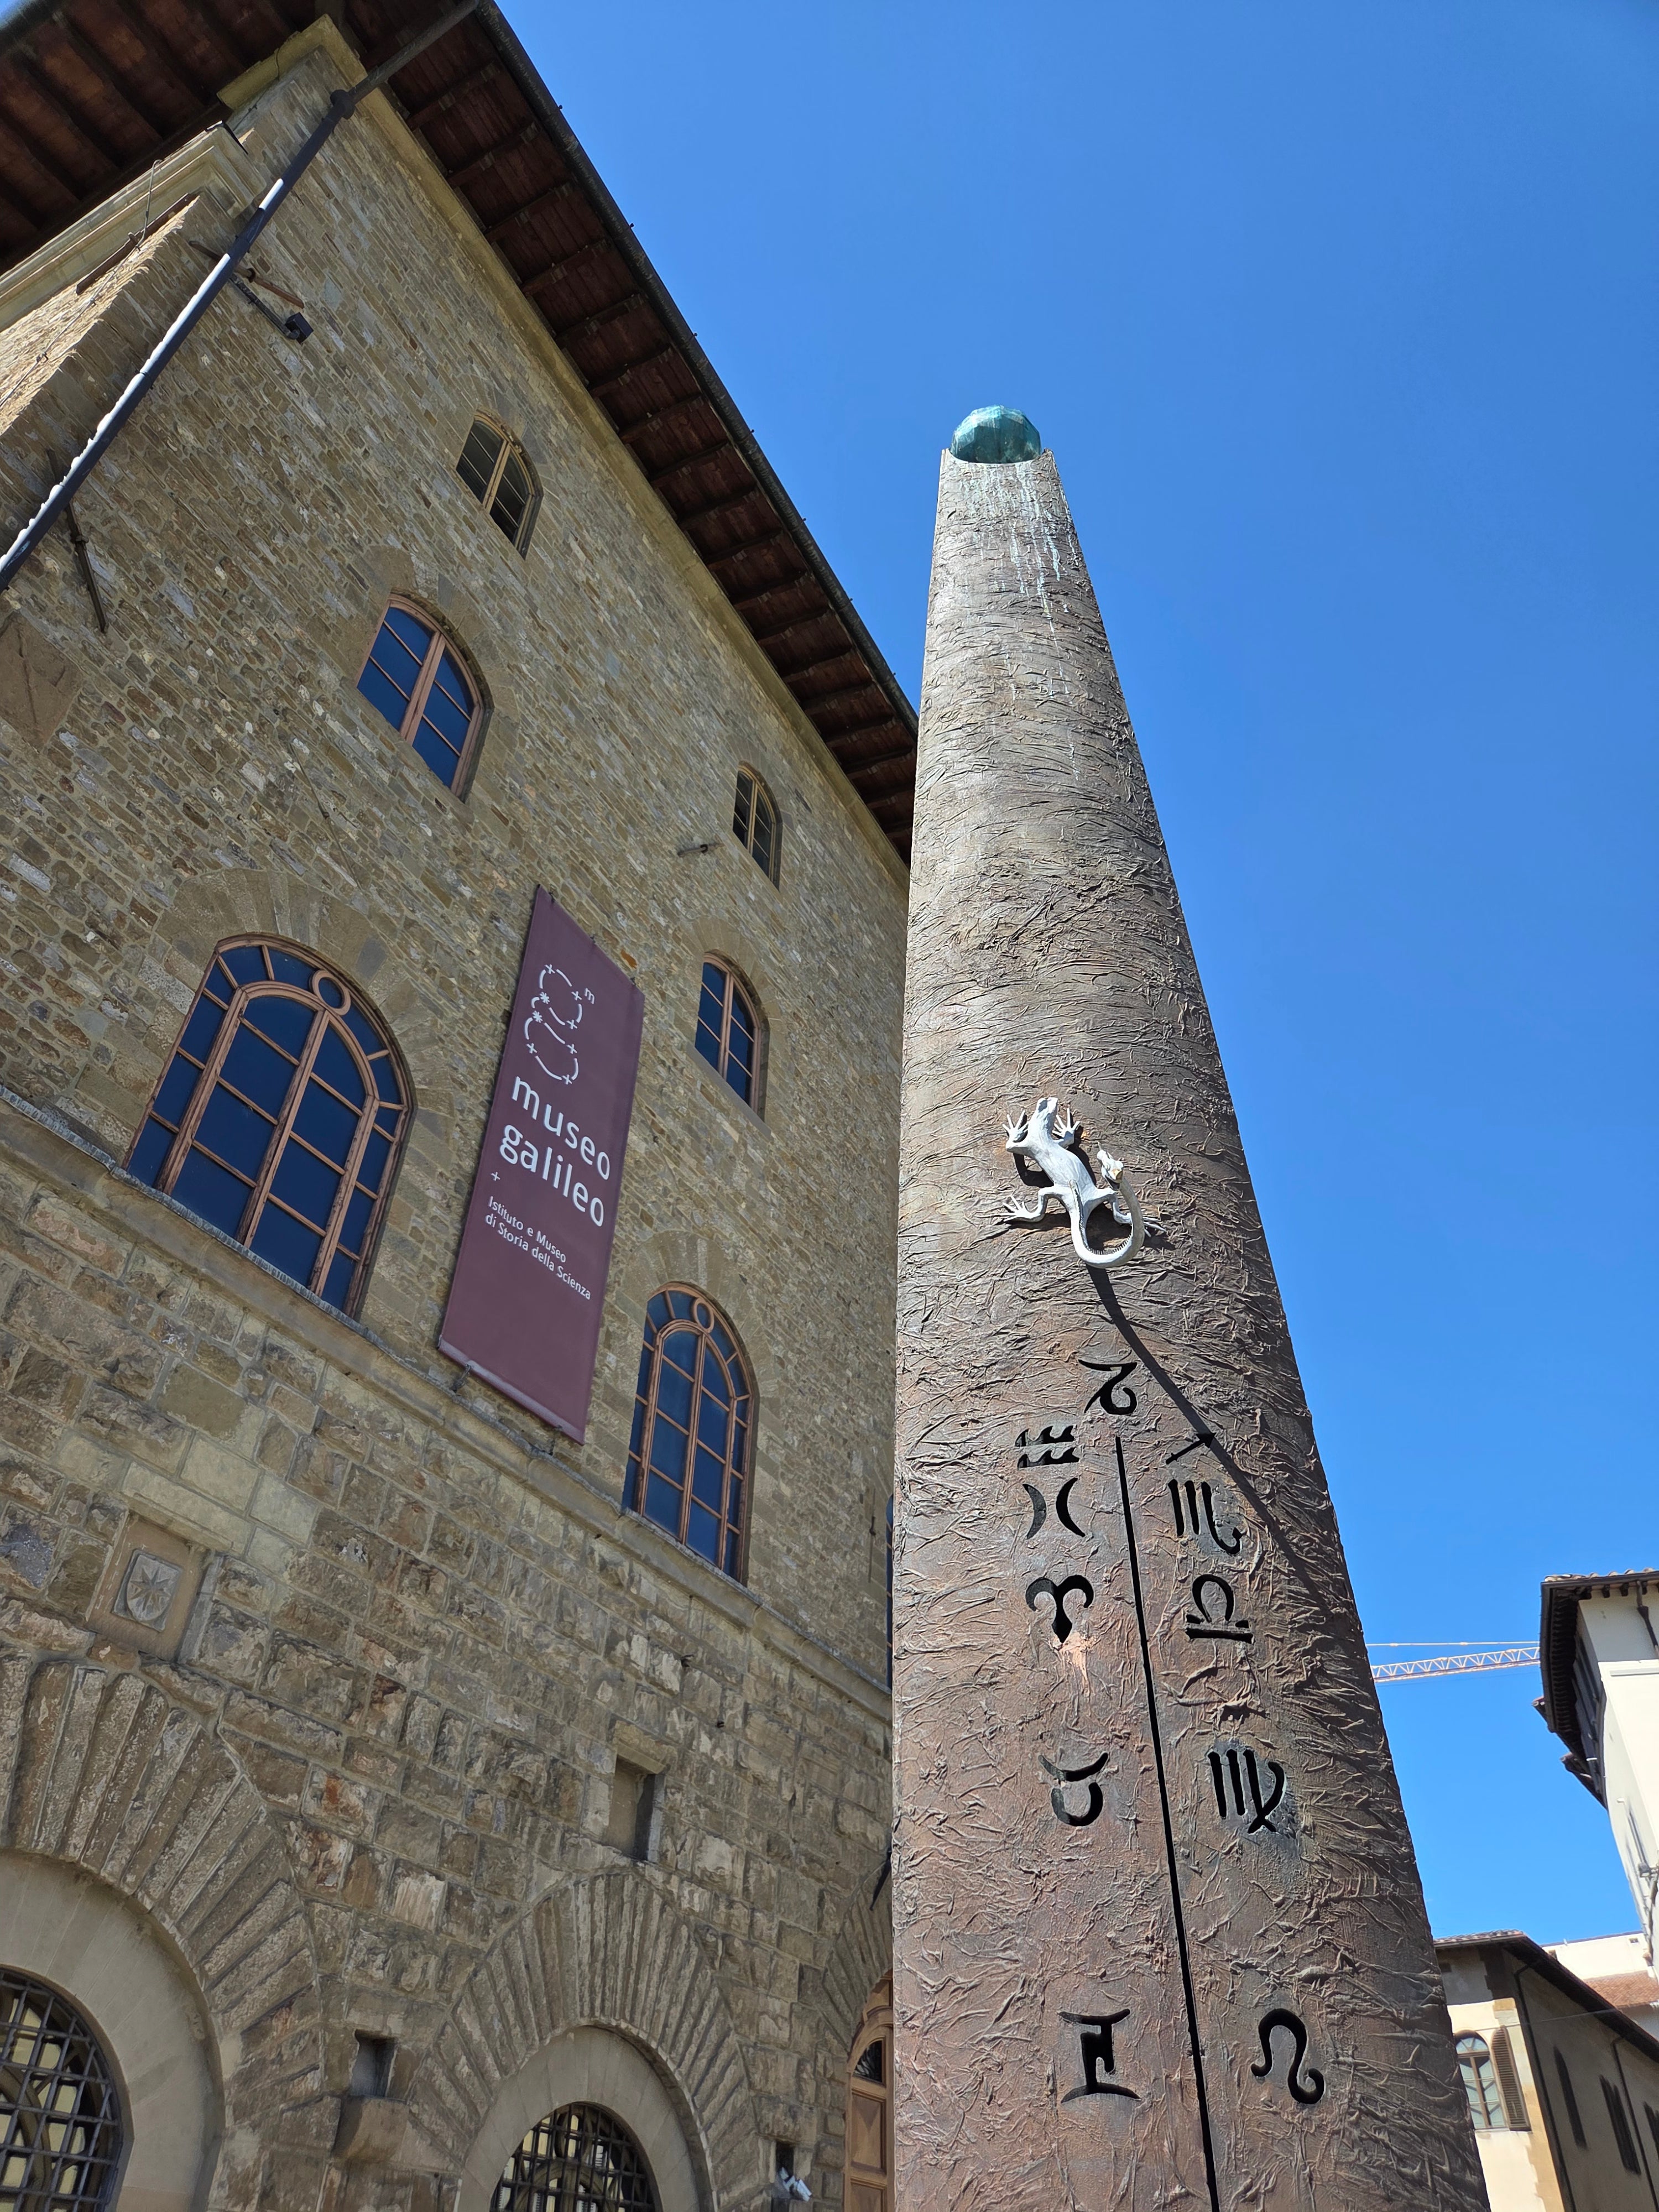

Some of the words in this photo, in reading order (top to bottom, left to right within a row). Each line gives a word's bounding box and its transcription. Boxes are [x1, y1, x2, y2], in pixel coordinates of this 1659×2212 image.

[500, 1124, 604, 1227] galileo
[512, 1076, 610, 1180] museo
[486, 1213, 497, 1228] di
[498, 1222, 529, 1251] Storia
[532, 1246, 555, 1271] della
[556, 1266, 591, 1300] Scienza
[488, 1196, 524, 1230] Istituto
[527, 1227, 534, 1237] e
[536, 1230, 566, 1263] Museo
